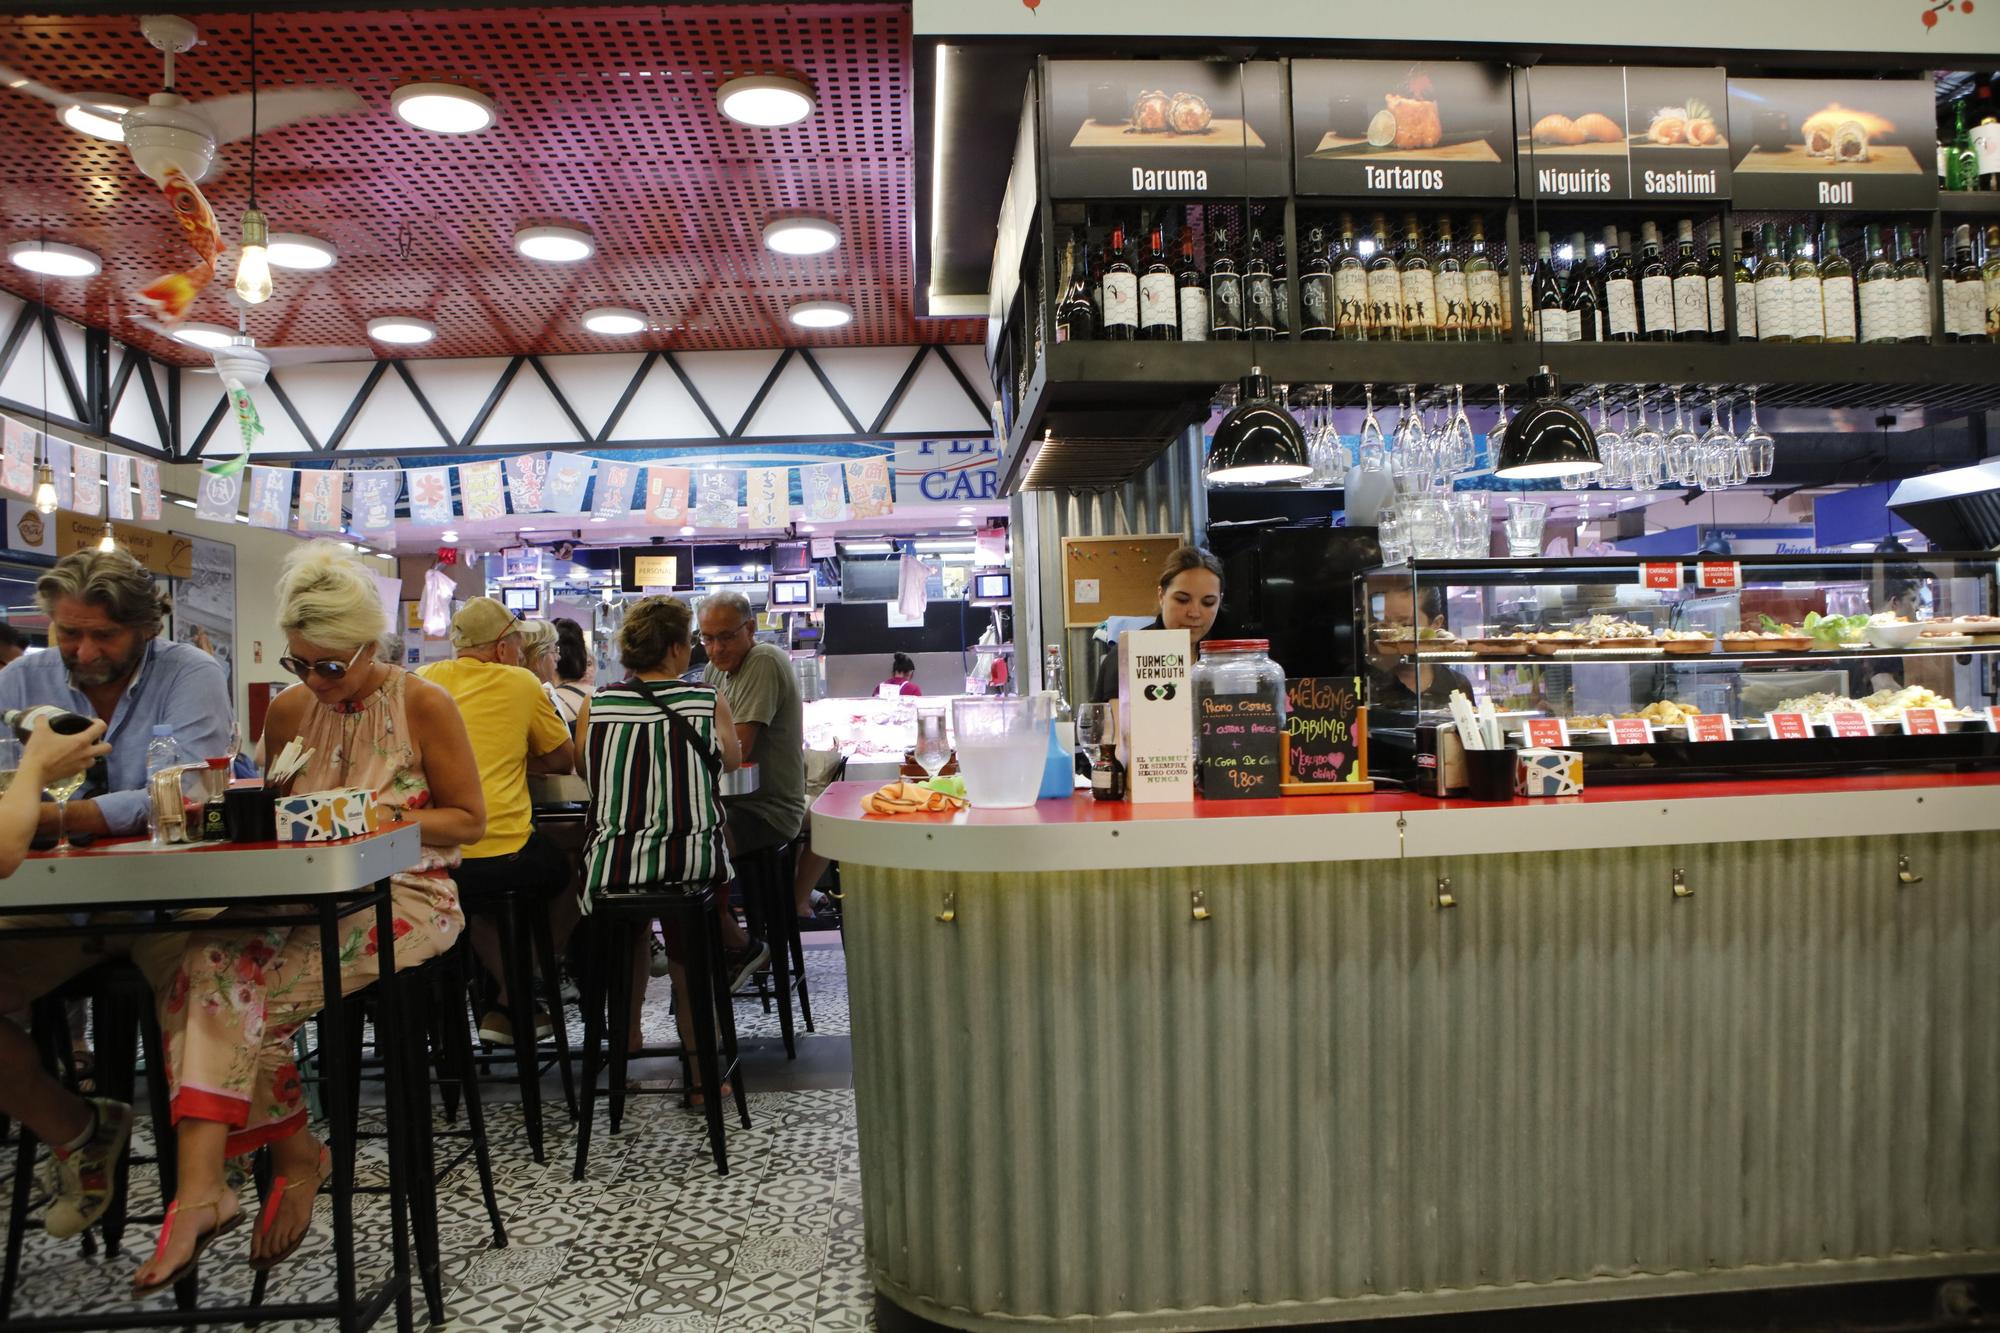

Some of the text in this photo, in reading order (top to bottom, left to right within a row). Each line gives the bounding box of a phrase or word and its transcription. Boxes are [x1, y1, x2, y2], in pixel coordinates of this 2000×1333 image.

[1131, 166, 1208, 191] Daruma
[1364, 165, 1444, 190] Tartaros
[1538, 168, 1612, 196] Niguiris
[1644, 169, 1717, 194] Sashimi
[1818, 181, 1853, 204] Roll
[1136, 655, 1184, 668] TURMEON
[1136, 668, 1185, 679] VERMOUTH
[1203, 723, 1212, 736] 2
[1287, 716, 1348, 743] DARUMA
